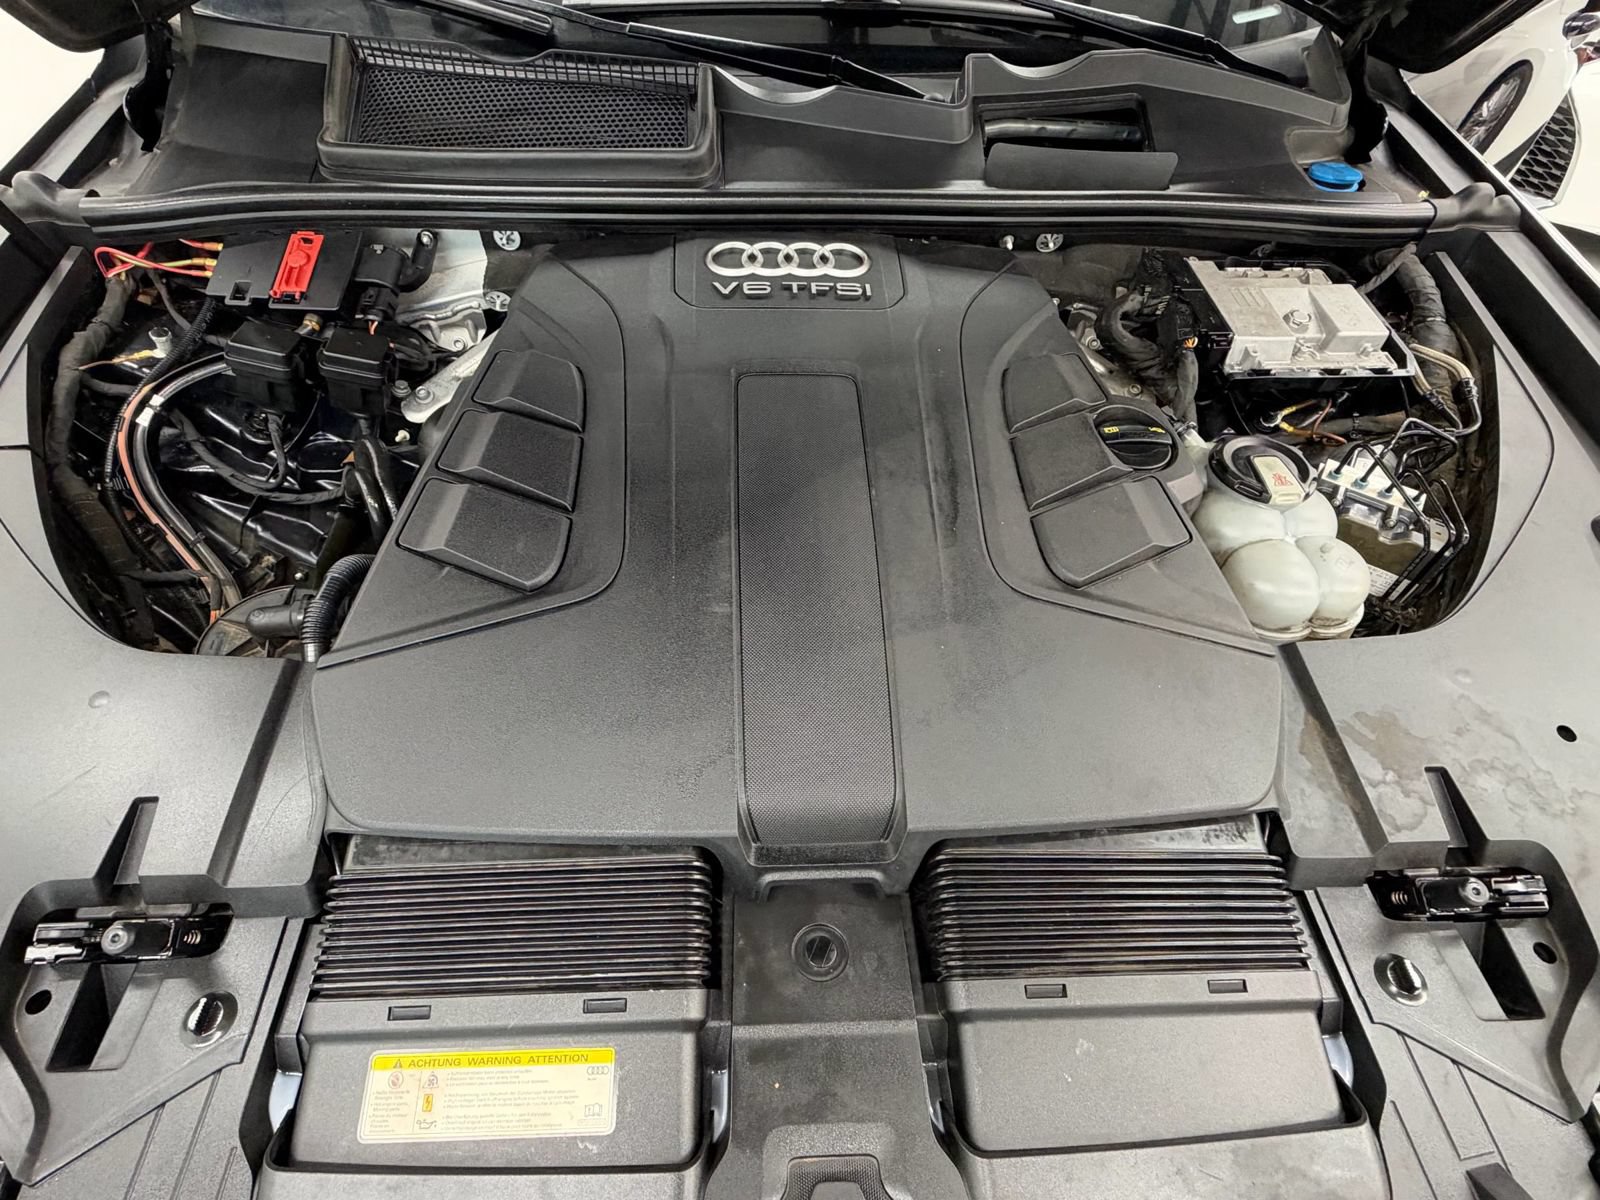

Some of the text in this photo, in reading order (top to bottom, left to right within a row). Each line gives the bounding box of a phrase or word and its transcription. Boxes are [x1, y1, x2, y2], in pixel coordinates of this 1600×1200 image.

[712, 281, 872, 296] V6 TFSI
[408, 1053, 589, 1068] ACHTUNG WARNING ATTENTION
